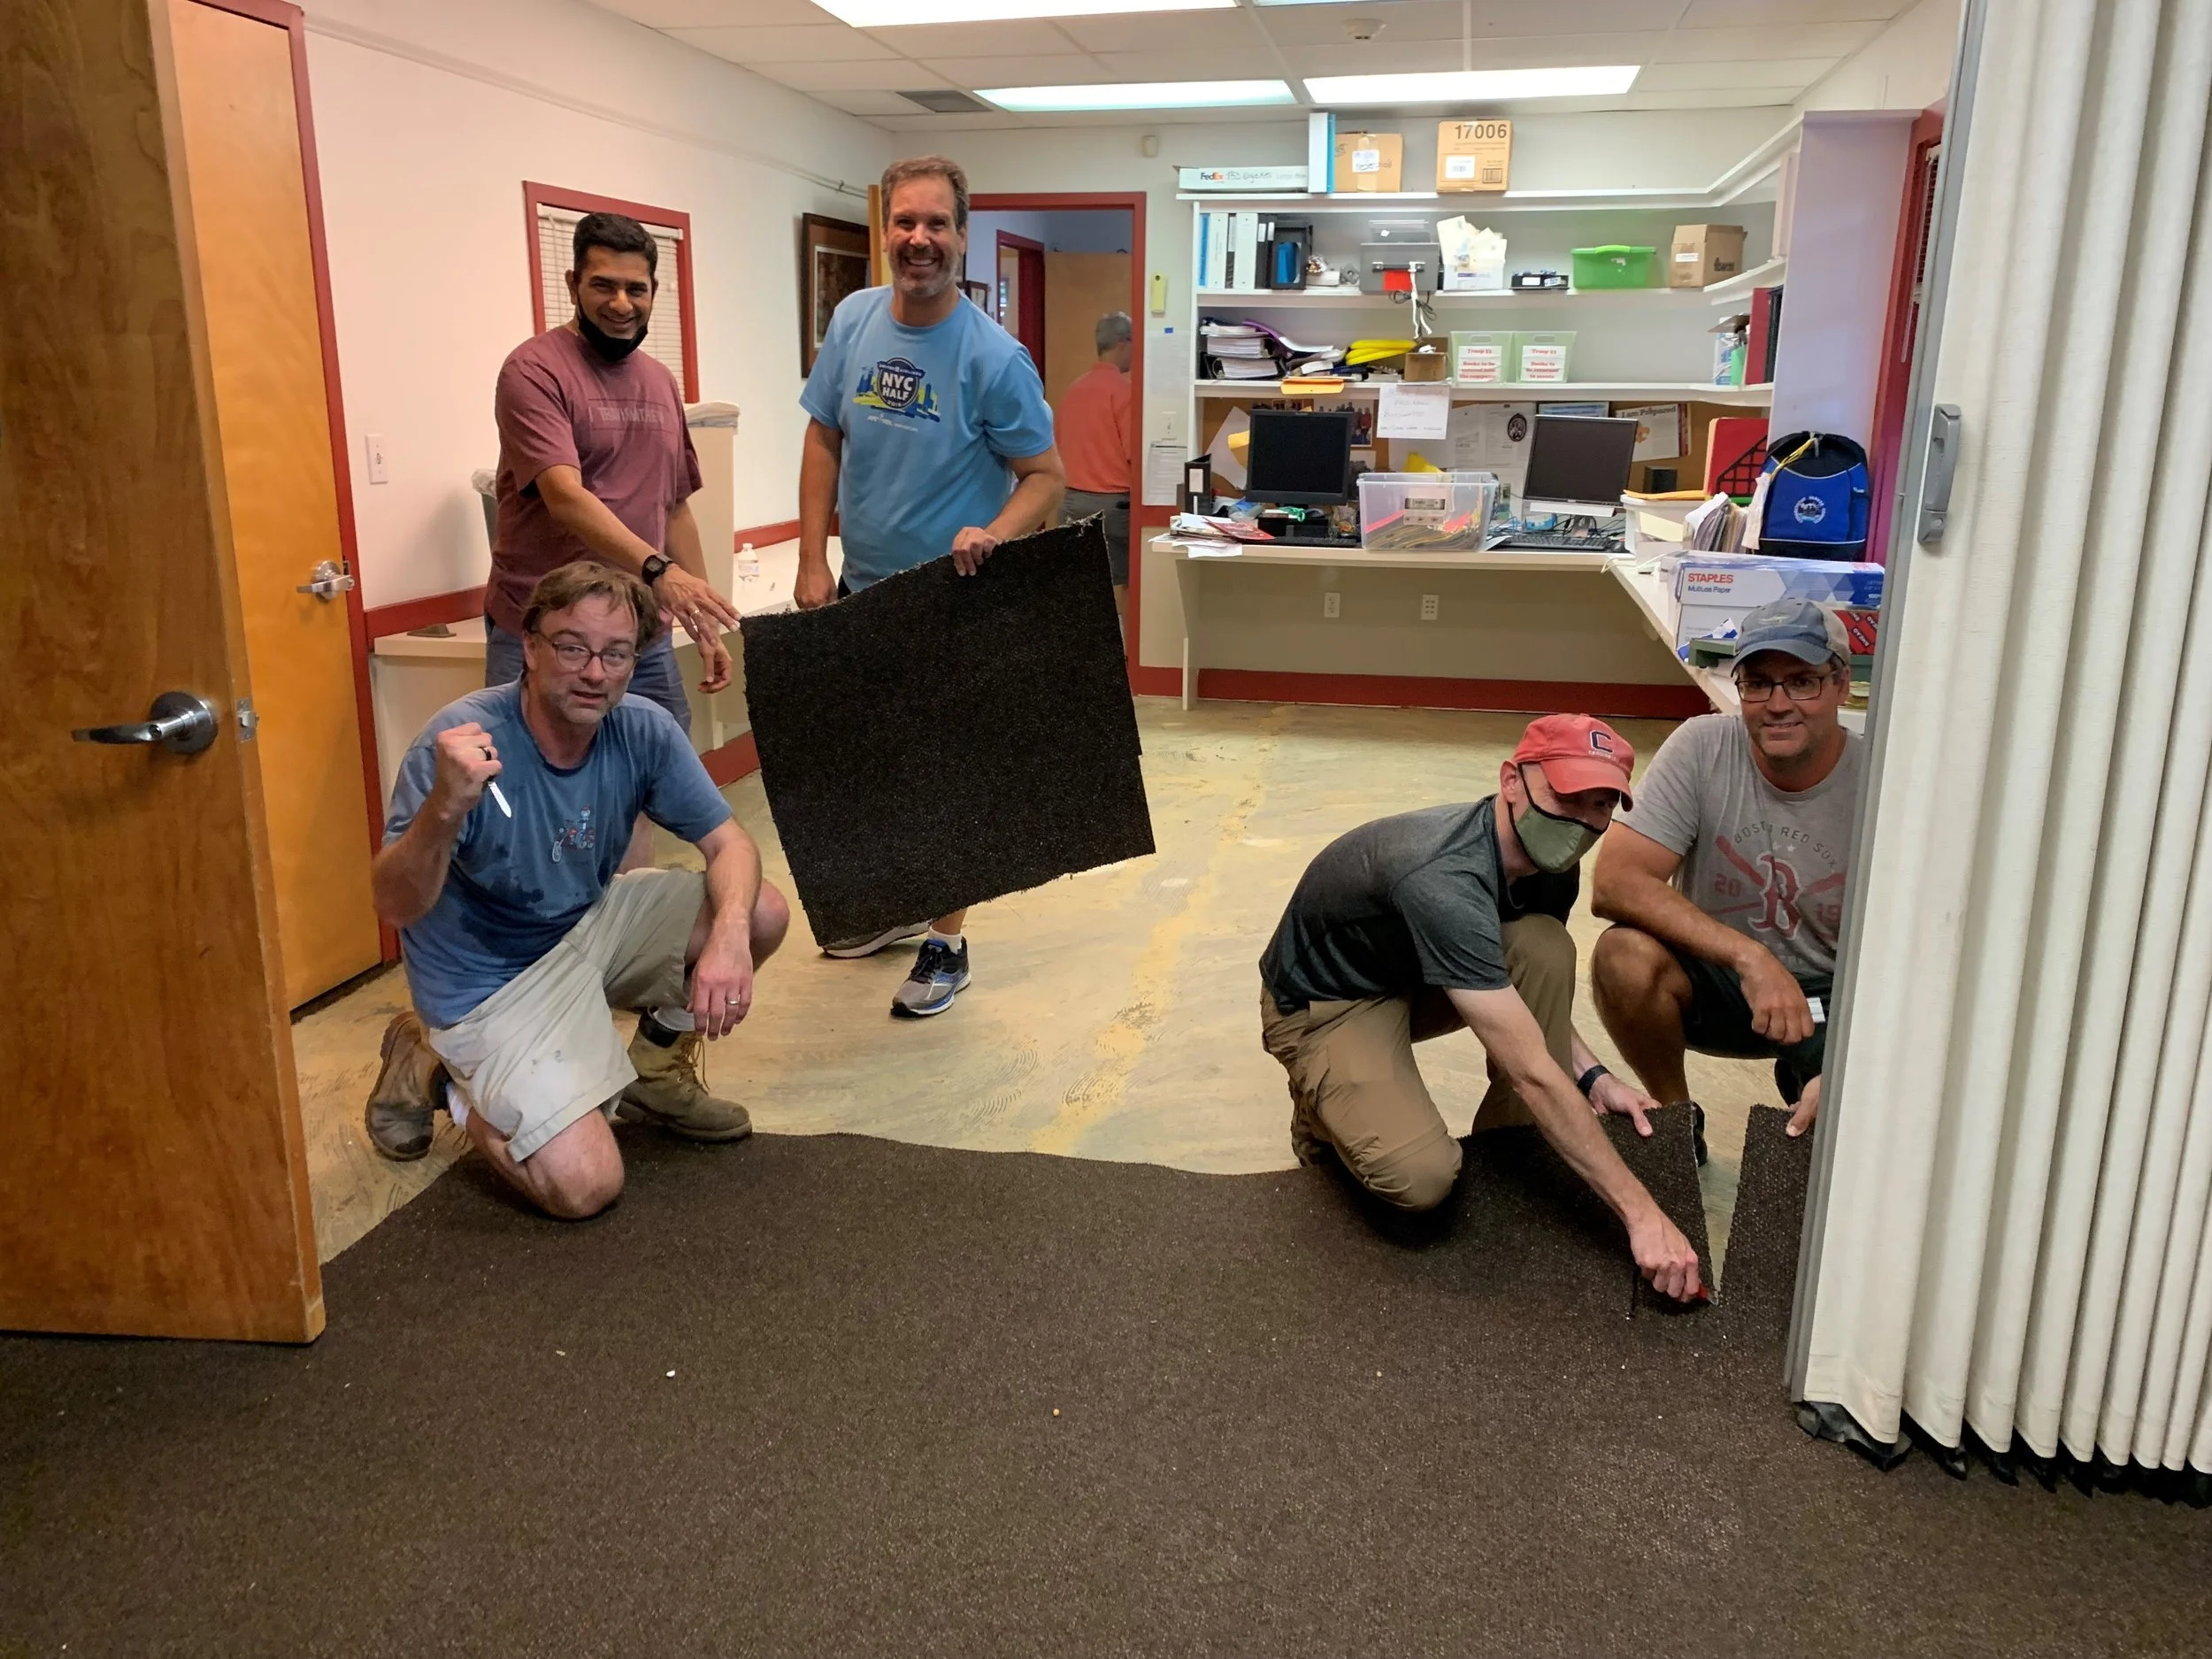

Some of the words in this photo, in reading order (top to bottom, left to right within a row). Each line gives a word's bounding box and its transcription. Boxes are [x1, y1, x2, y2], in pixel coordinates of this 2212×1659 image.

[1455, 124, 1507, 139] 17006
[1201, 172, 1224, 180] FedEx
[882, 372, 914, 391] NYC
[882, 387, 909, 401] HALF
[1687, 572, 1734, 584] STAPLES
[1853, 627, 1870, 647] SMEAD
[1590, 730, 1614, 754] C
[1734, 821, 1773, 844] BOST
[1780, 826, 1810, 844] RED
[1813, 842, 1836, 868] SOX
[1715, 872, 1742, 897] 20
[1747, 850, 1801, 941] B
[1816, 902, 1841, 922] 19
